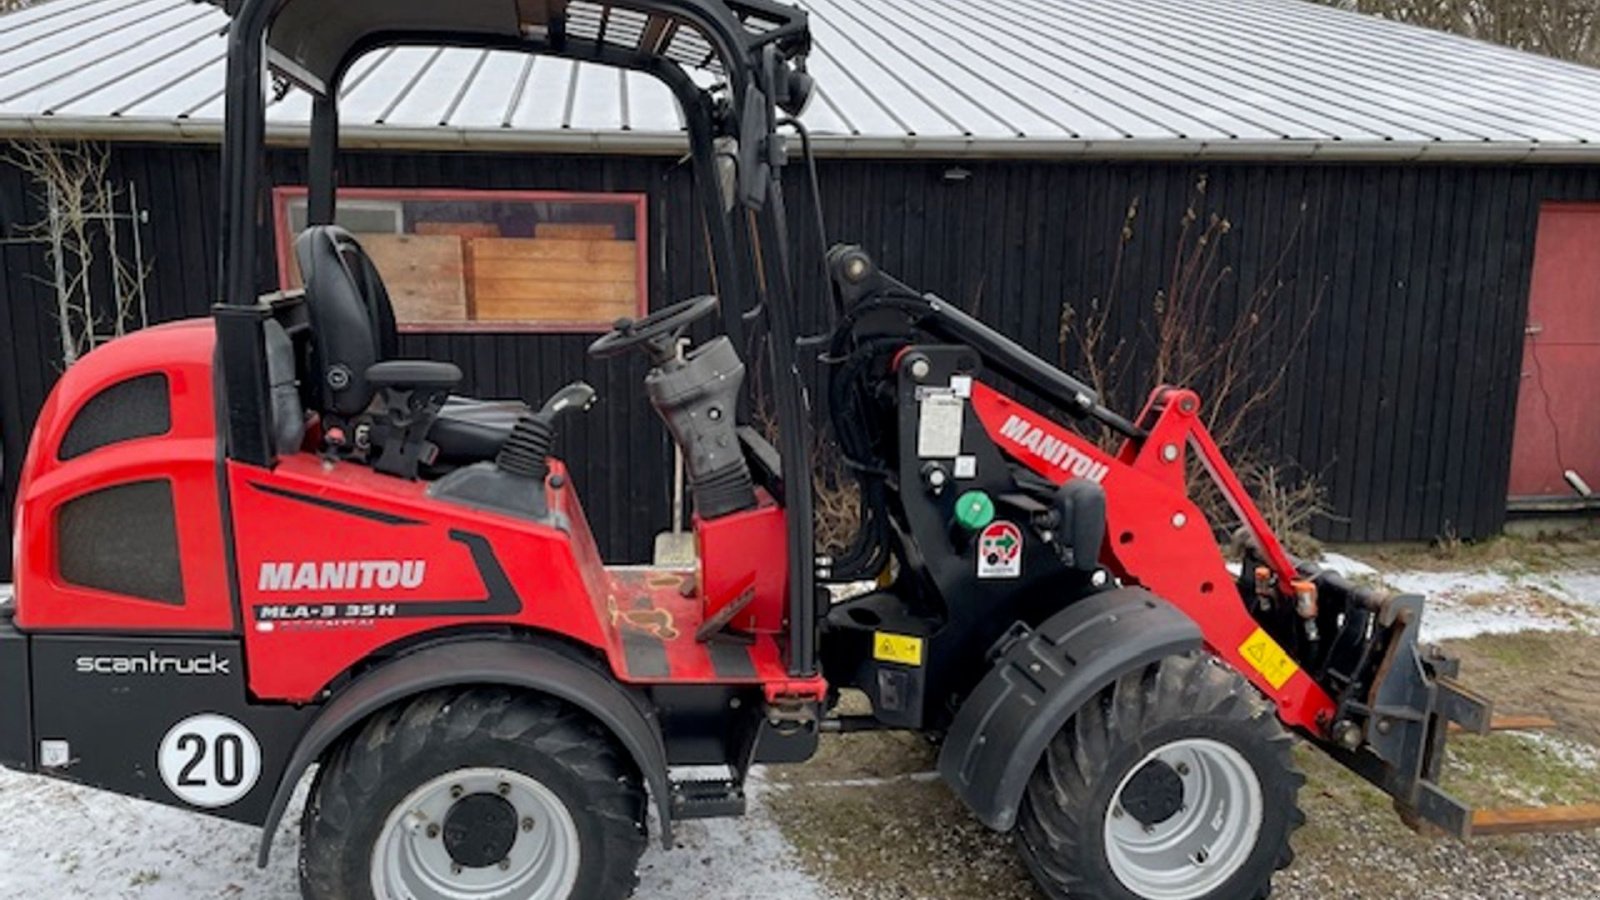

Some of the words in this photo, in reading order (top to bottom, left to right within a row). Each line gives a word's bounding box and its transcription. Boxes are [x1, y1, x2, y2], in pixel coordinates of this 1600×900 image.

[999, 414, 1109, 483] MANITOU
[258, 560, 426, 591] MANITOU
[76, 651, 230, 673] scantruck
[177, 733, 244, 787] 20
